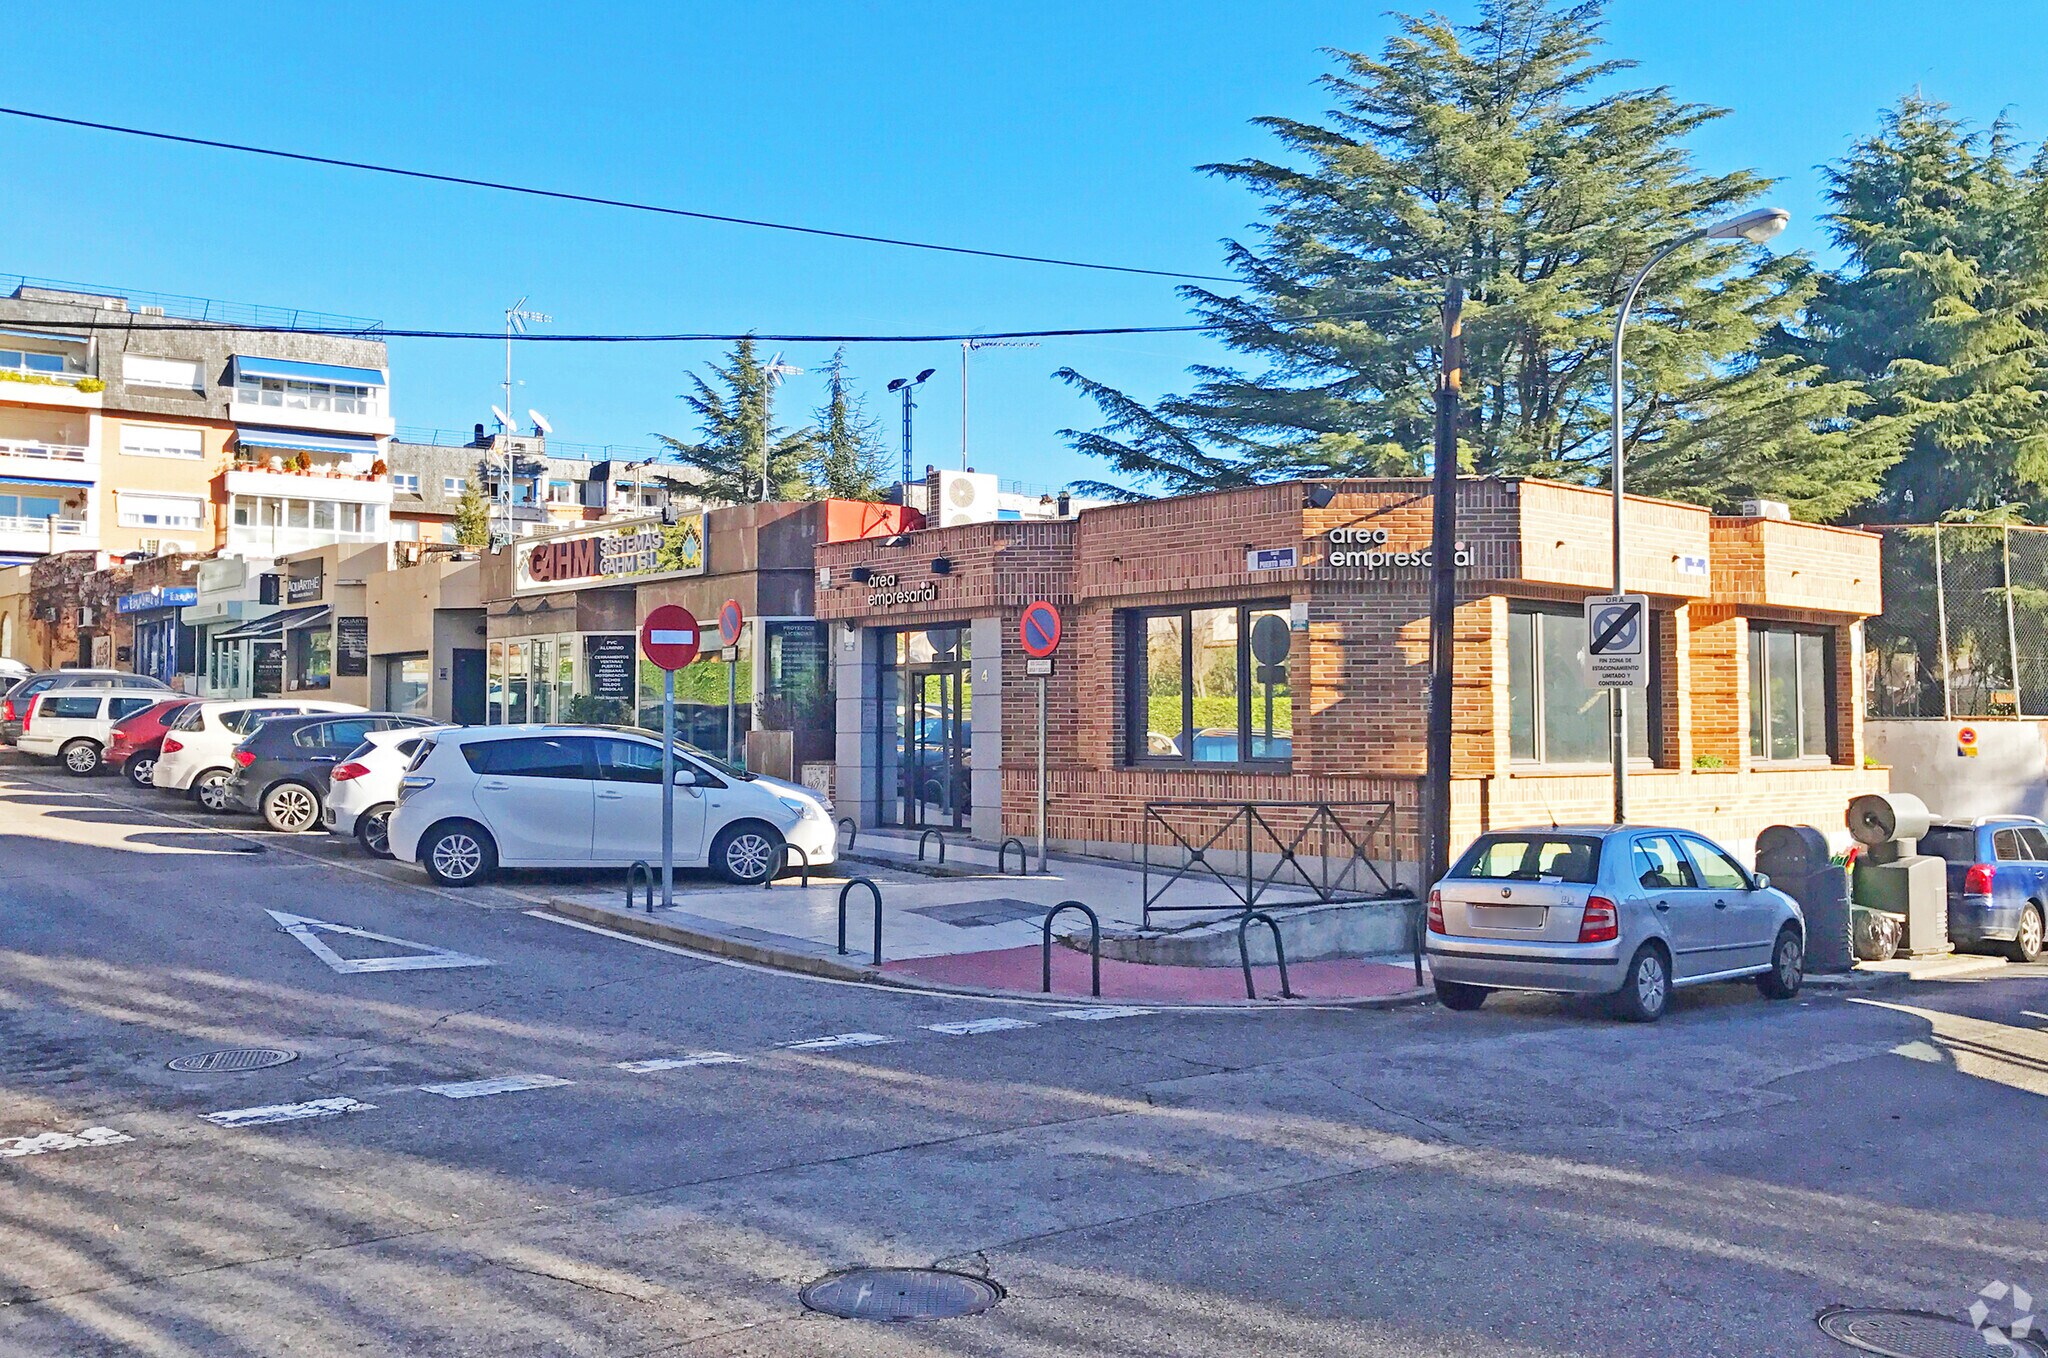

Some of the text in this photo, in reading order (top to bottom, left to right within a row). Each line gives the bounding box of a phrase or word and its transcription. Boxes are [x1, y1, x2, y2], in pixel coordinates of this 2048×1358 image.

[600, 532, 662, 557] SISTEMAS
[1329, 541, 1475, 571] empresaal
[529, 537, 597, 583] GAHM
[600, 555, 635, 575] GAHM
[868, 574, 896, 588] área
[867, 581, 936, 608] empresarial
[981, 669, 989, 683] 4
